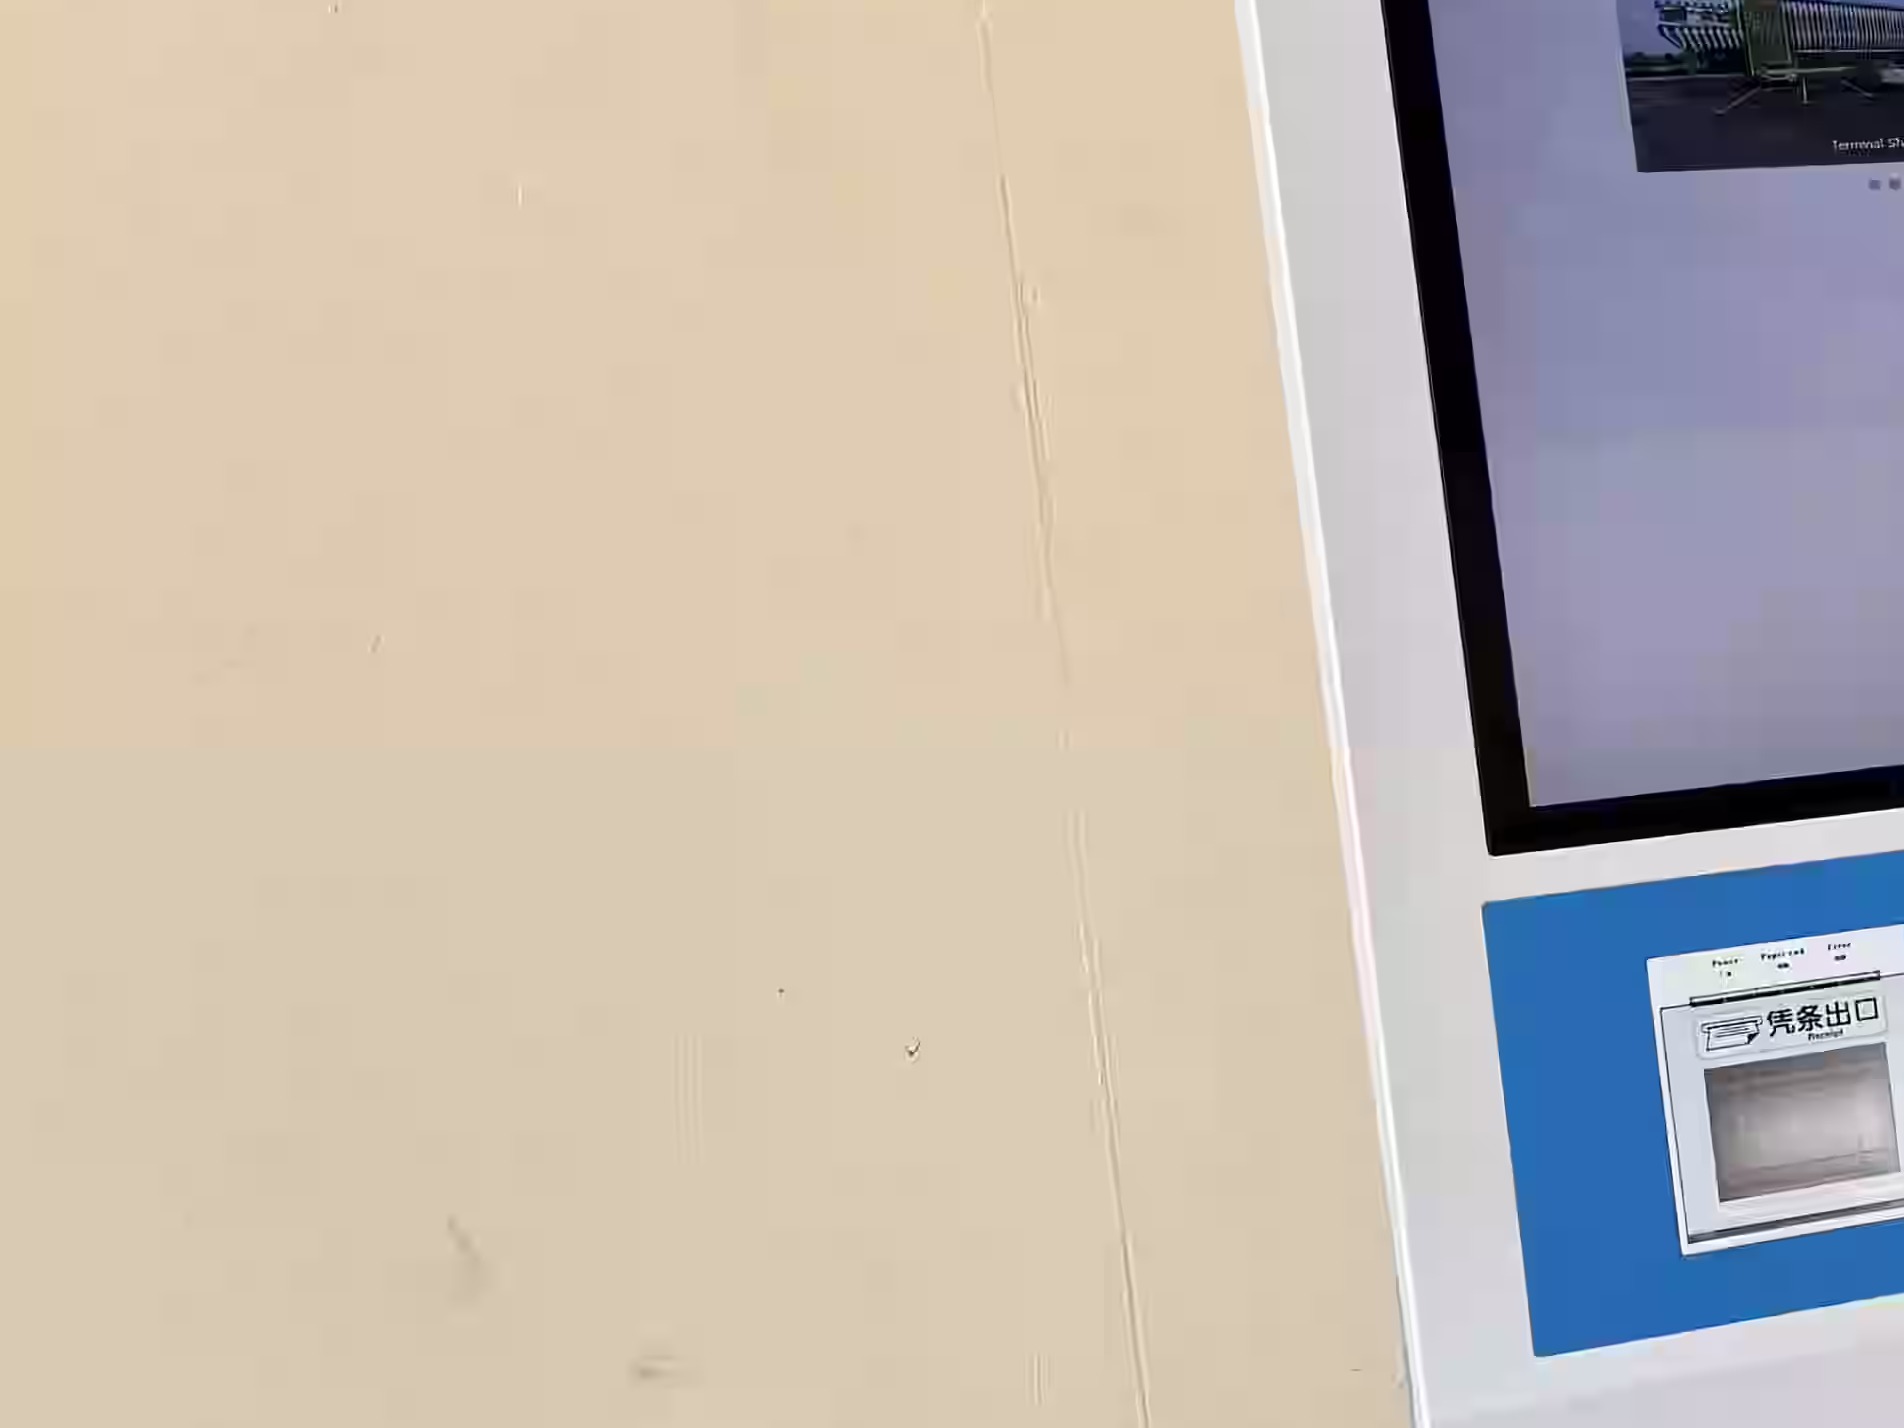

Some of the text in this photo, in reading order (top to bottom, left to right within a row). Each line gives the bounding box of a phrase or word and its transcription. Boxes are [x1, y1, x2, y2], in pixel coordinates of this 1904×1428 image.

[1833, 138, 1884, 151] Terminal
[1767, 997, 1879, 1037] 凭条出口
